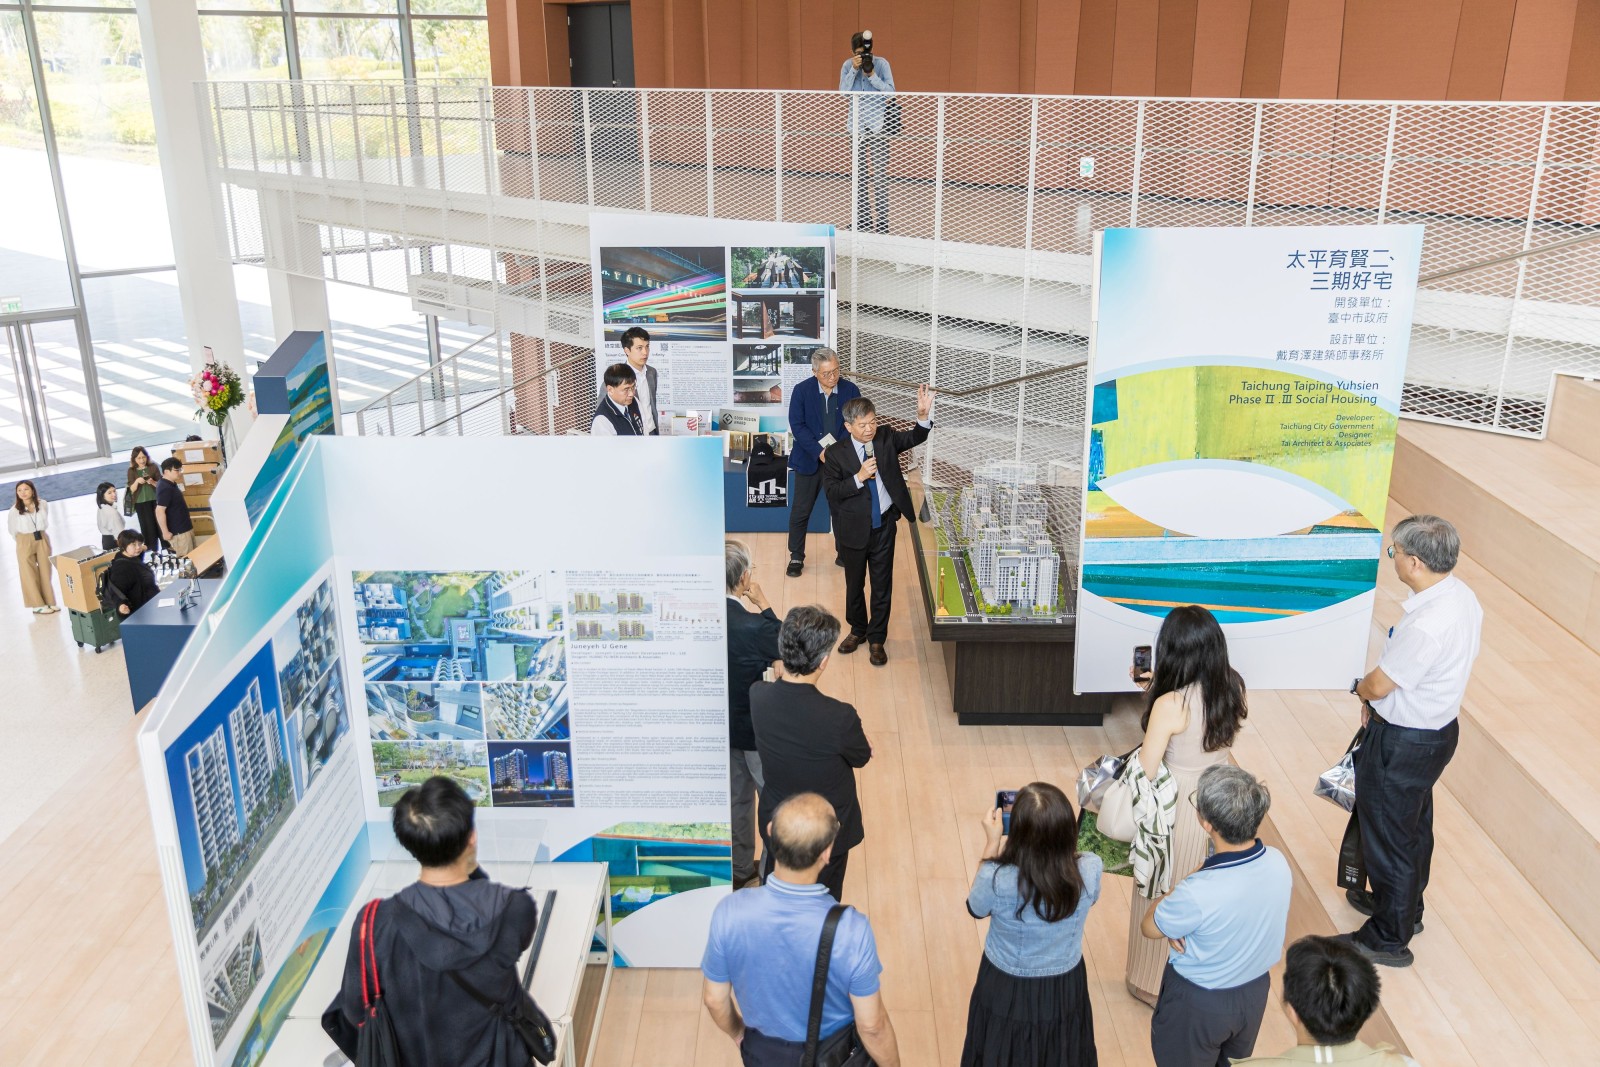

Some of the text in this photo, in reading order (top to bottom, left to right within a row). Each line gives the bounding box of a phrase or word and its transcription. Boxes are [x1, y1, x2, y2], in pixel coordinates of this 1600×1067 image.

[1286, 249, 1394, 269] 太平育賢二、
[1310, 271, 1393, 290] 三期好宅
[1327, 312, 1389, 324] 臺中市政府
[1275, 349, 1385, 361] 戴育澤建築師事務所
[1241, 380, 1379, 393] Taichung Taiping Yuhsien
[1229, 394, 1262, 405] Phase
[1295, 394, 1329, 405] Social
[1331, 394, 1378, 407] Housing
[1335, 414, 1375, 423] Developer:
[1280, 423, 1374, 432] Taichung City Government
[1338, 431, 1373, 440] Designer:
[1292, 440, 1325, 448] Architect
[1334, 440, 1372, 448] Associates
[571, 643, 600, 651] Juneyeh
